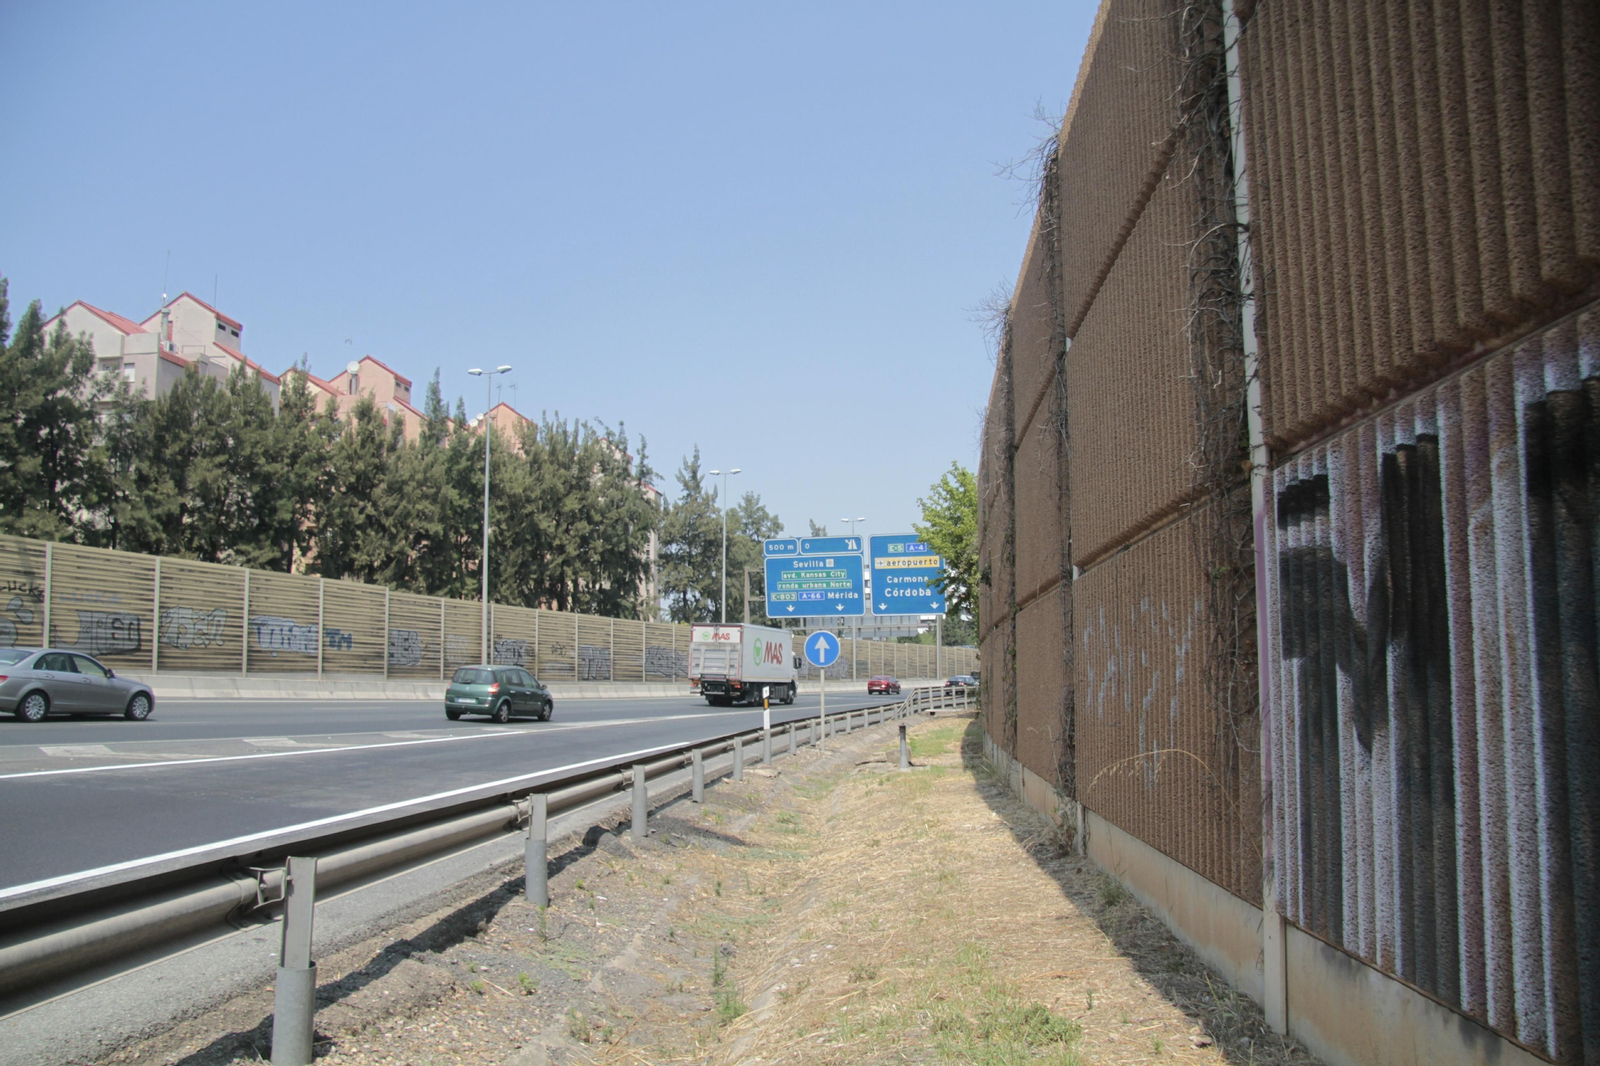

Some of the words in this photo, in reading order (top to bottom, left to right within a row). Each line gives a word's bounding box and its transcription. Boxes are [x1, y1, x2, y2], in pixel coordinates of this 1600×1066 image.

[793, 560, 824, 568] Sevilla
[886, 558, 938, 567] aeropuerto
[830, 570, 846, 579] City
[886, 575, 929, 583] Carmona
[827, 591, 859, 599] Mérida
[884, 588, 932, 597] Córdoba
[711, 632, 731, 640] MAS
[763, 641, 783, 665] MAS
